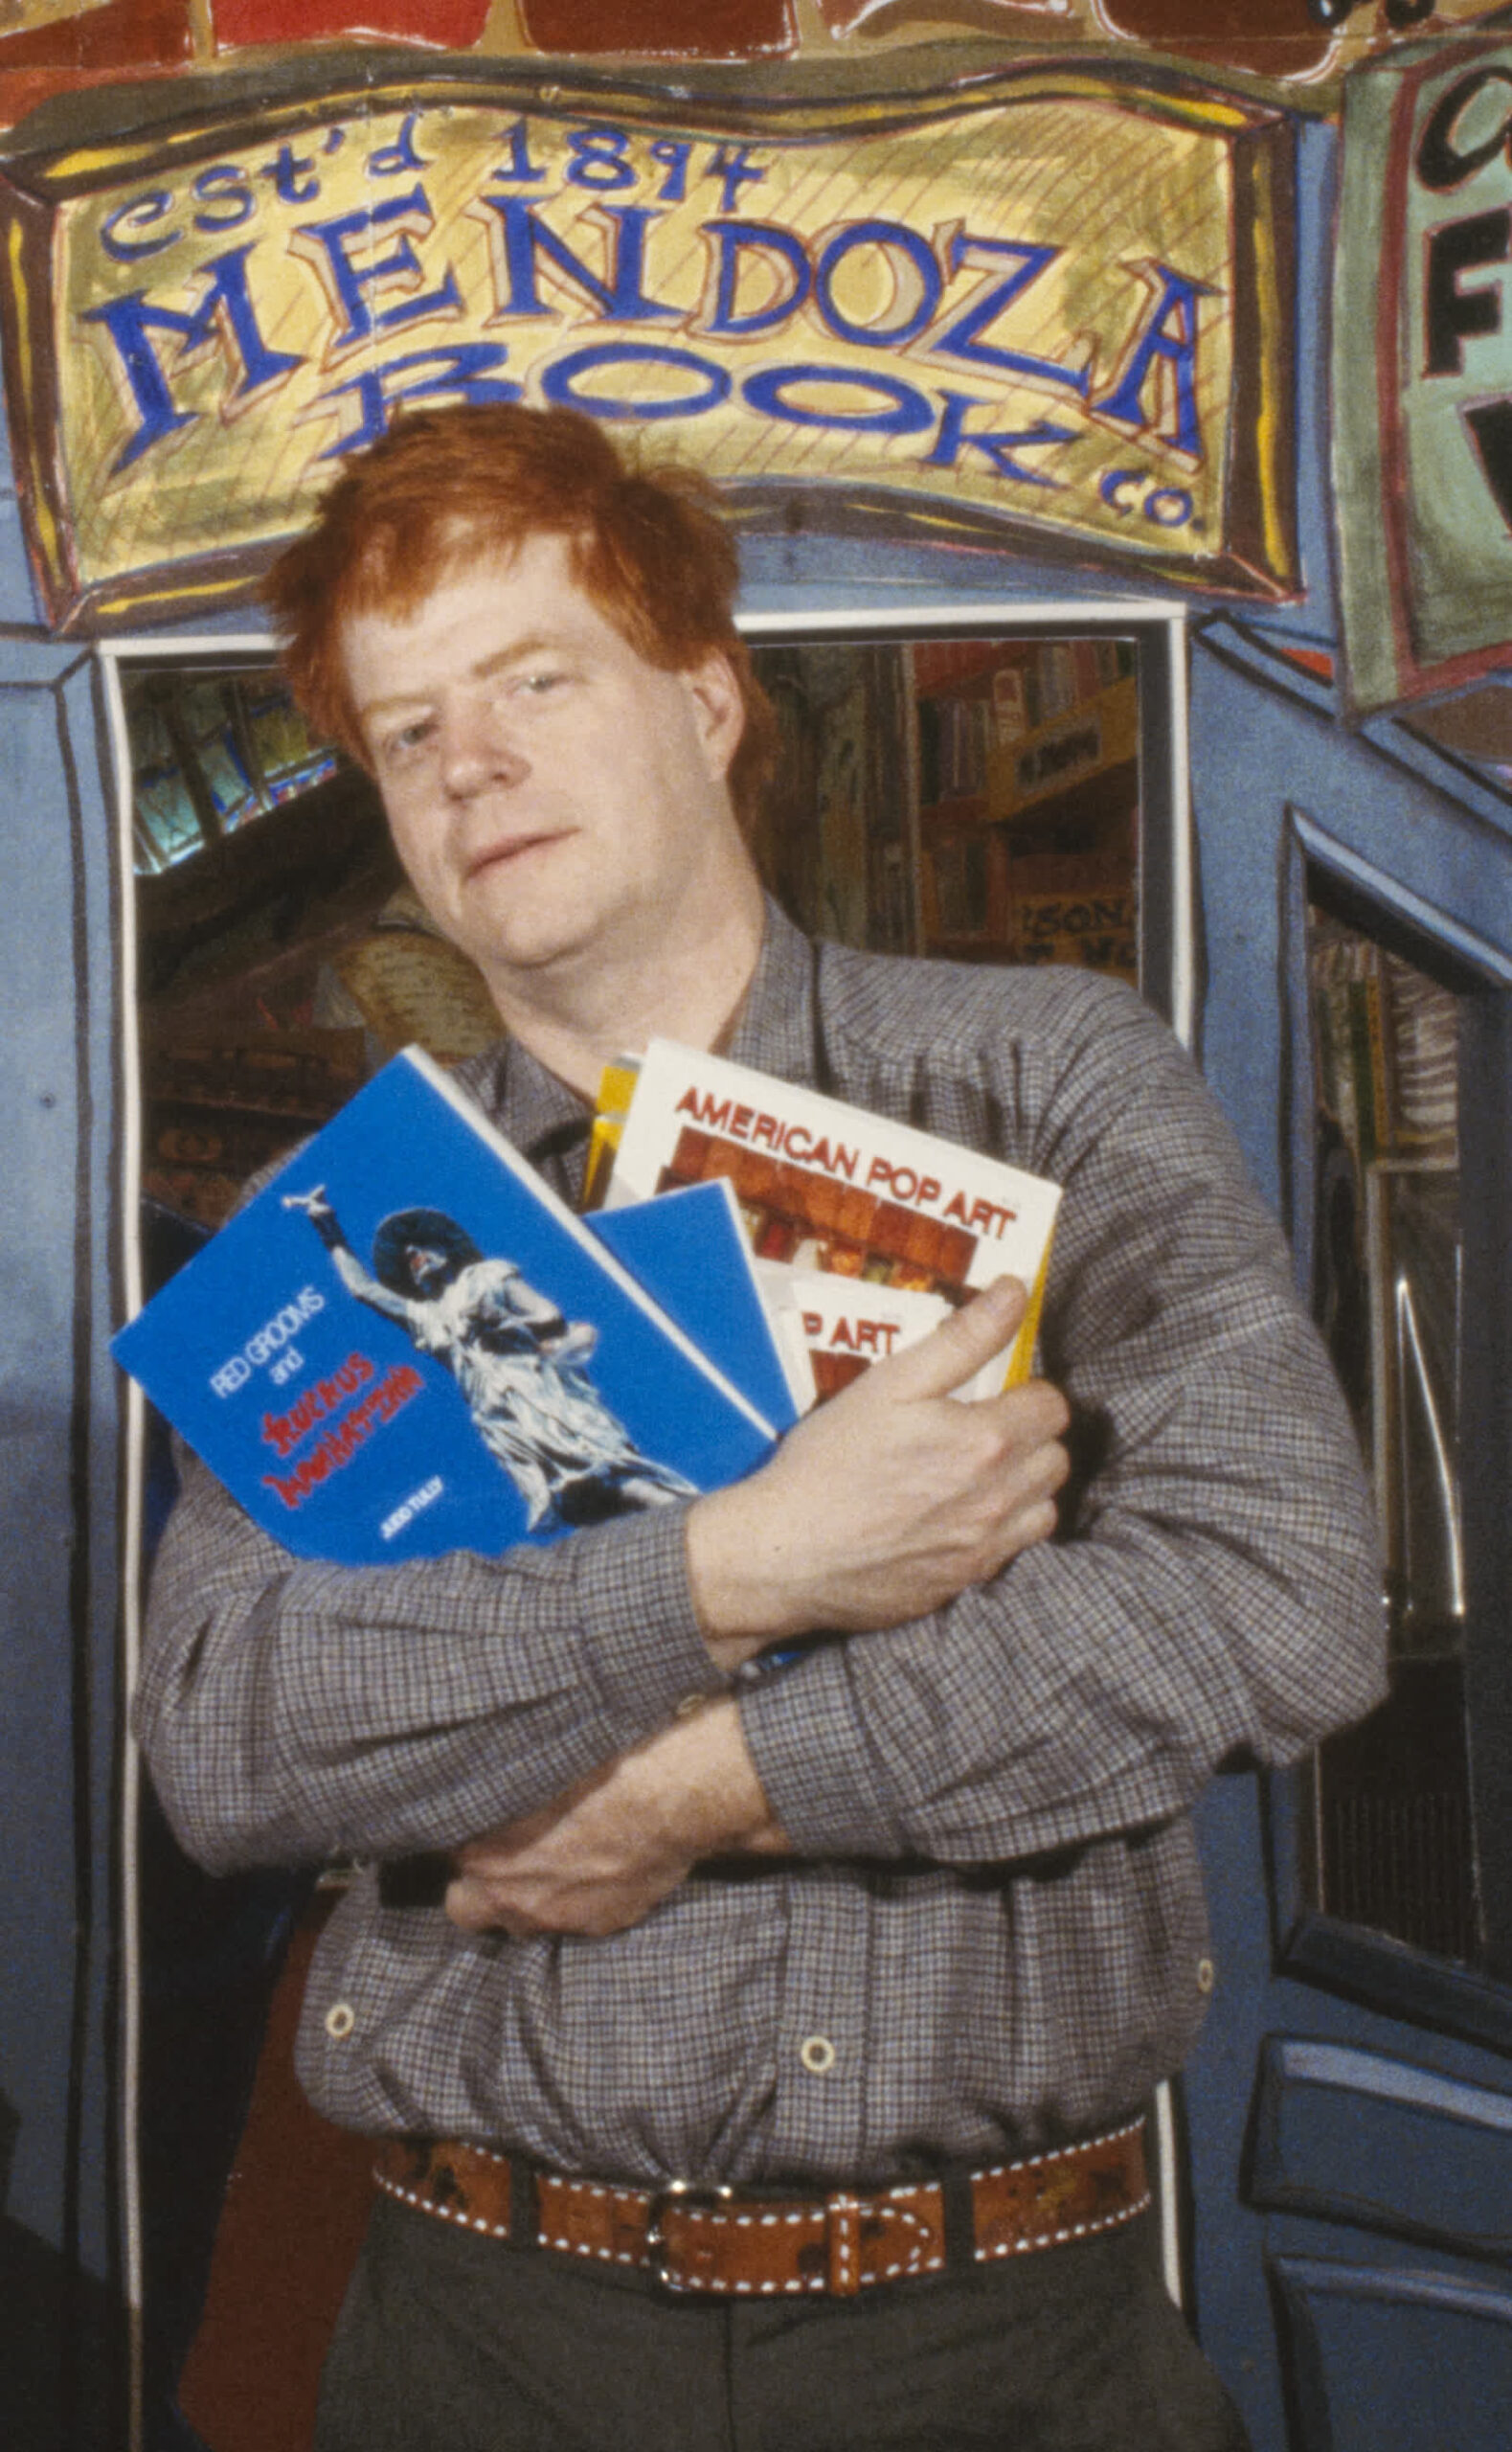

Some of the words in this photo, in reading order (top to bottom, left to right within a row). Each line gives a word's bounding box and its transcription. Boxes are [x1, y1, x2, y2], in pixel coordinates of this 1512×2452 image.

[492, 118, 768, 213] 1894
[80, 182, 1229, 473] MENDOZA
[316, 341, 1086, 487] BOOK
[674, 1085, 861, 1180] AMERICAN
[866, 1155, 943, 1206] POP
[943, 1189, 1018, 1240] ART
[209, 1354, 252, 1399] RED
[244, 1284, 326, 1366] GROOMS
[269, 1344, 305, 1386] and
[828, 1315, 901, 1355] ART
[261, 1351, 375, 1458] RUCKUS
